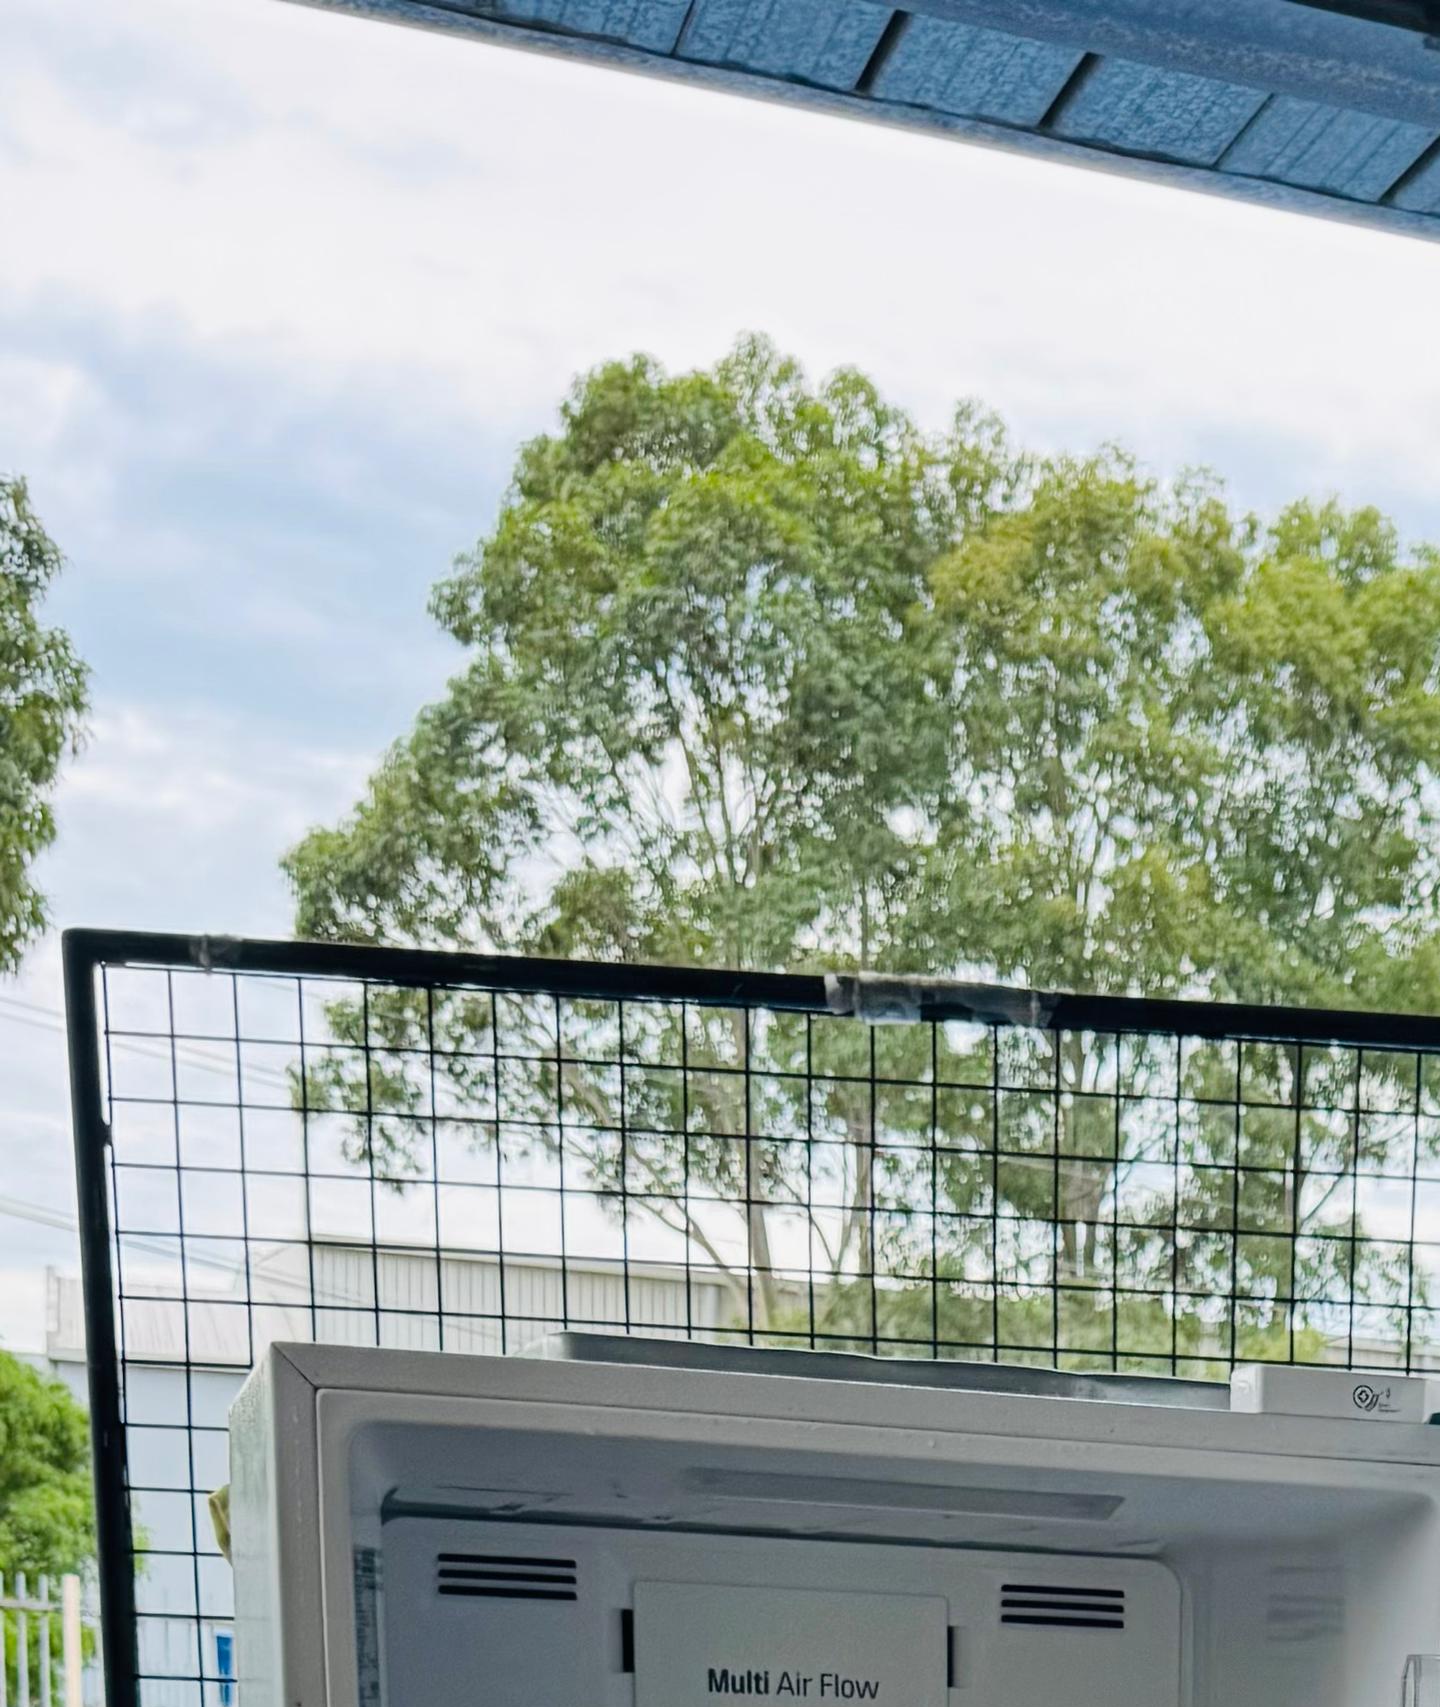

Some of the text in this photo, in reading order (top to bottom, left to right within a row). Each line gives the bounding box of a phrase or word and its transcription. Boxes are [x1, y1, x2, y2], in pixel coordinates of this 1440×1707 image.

[708, 1668, 879, 1699] Multi Air Flow
